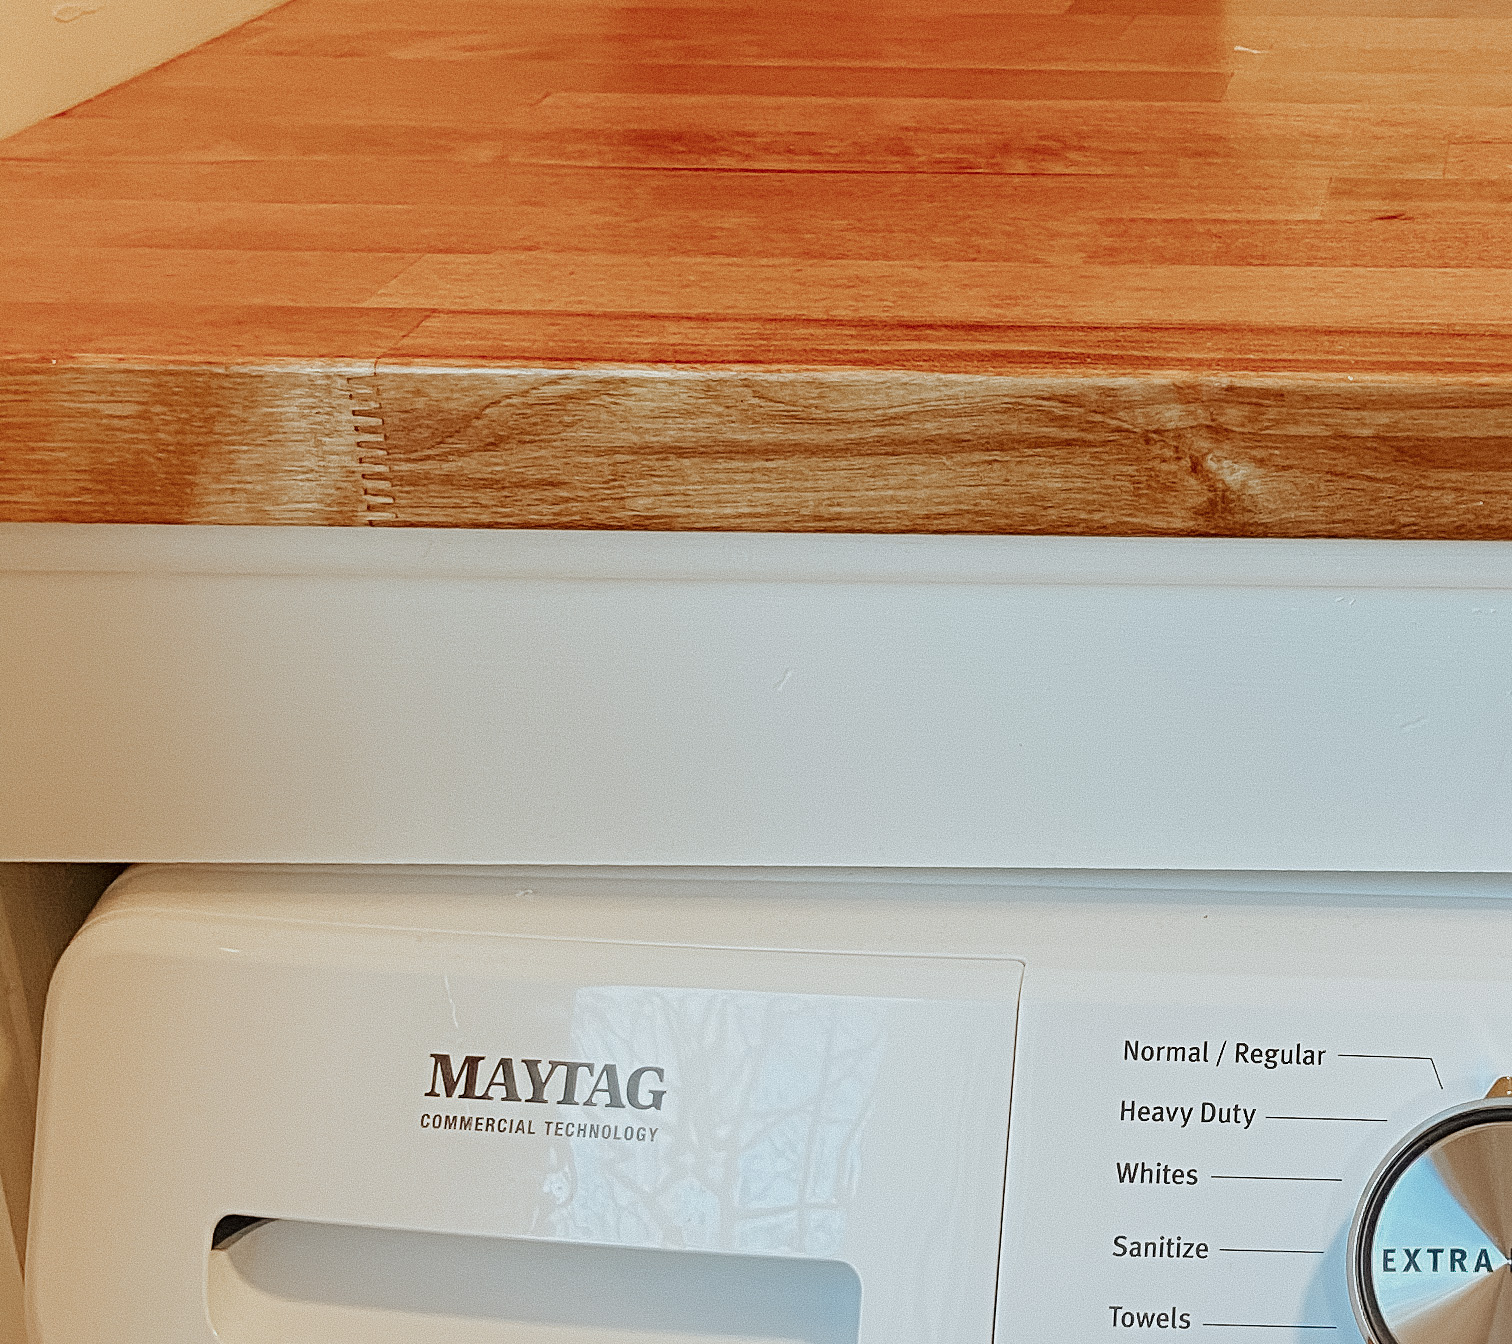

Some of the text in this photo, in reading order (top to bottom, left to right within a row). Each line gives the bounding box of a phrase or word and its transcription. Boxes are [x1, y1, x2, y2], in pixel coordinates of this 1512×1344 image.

[1123, 1040, 1209, 1063] Normal
[1234, 1042, 1327, 1069] Regular
[424, 1053, 667, 1110] MAYTAG
[420, 1113, 659, 1142] COMMERCIAL TECHNOLOGY
[1120, 1100, 1257, 1129] Heavy Duty
[1116, 1162, 1199, 1186] Whites
[1112, 1235, 1210, 1259] Sanitize
[1383, 1248, 1494, 1272] EXTRA
[1109, 1306, 1191, 1329] Towels
